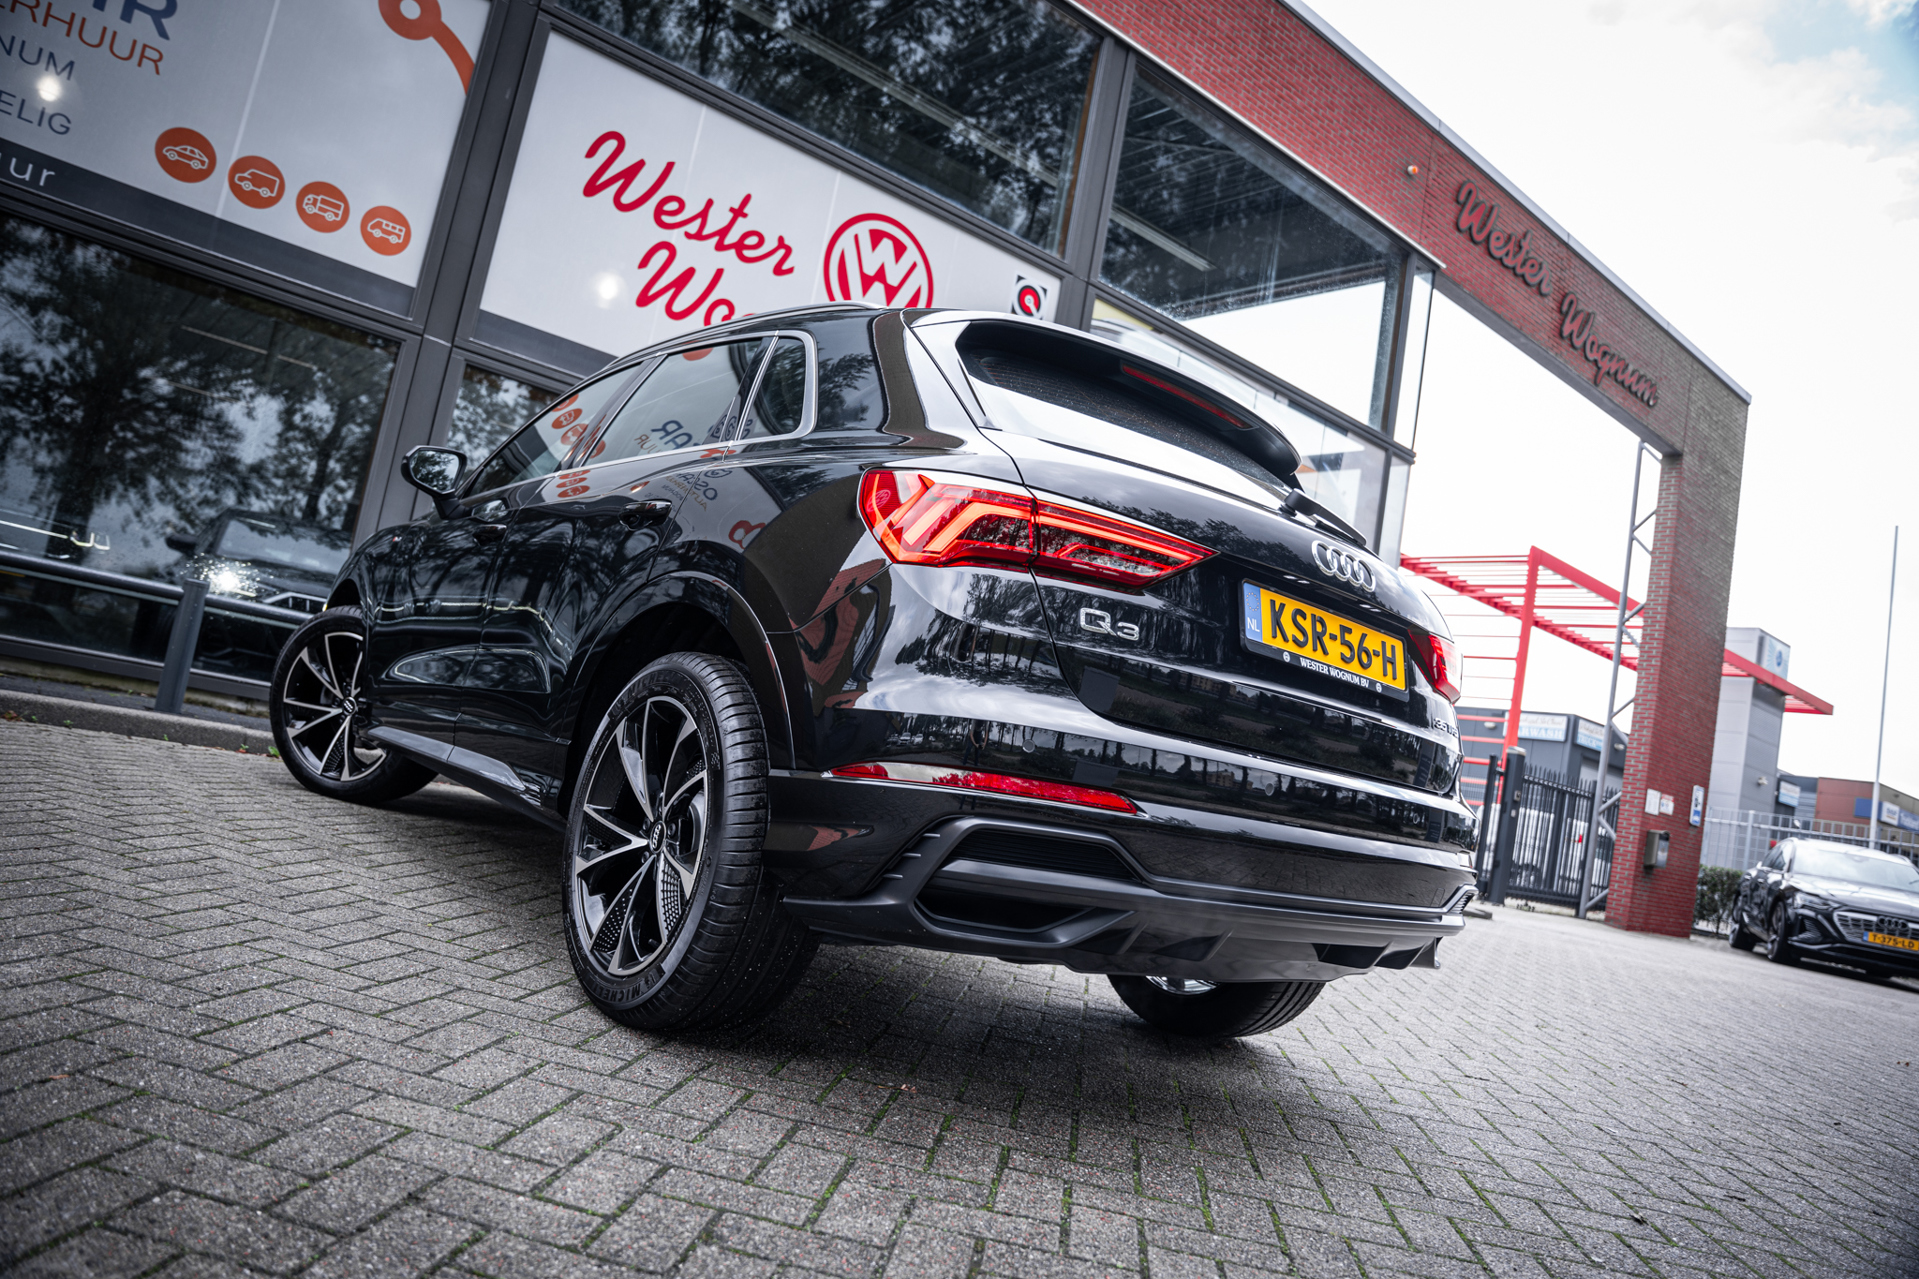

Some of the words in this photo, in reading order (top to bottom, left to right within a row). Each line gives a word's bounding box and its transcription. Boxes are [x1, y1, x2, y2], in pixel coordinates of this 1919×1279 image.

[0, 153, 56, 187] ur
[583, 131, 795, 277] Wester
[1456, 179, 1551, 297] Wester
[1559, 291, 1660, 408] Wognum
[1079, 607, 1140, 641] Q3
[1247, 616, 1261, 633] NL
[1269, 598, 1398, 681] KSR-56-H
[1300, 657, 1330, 675] WESTER
[1329, 666, 1360, 686] WOGNUM
[1360, 677, 1370, 688] BV
[1518, 726, 1563, 740] RWASH
